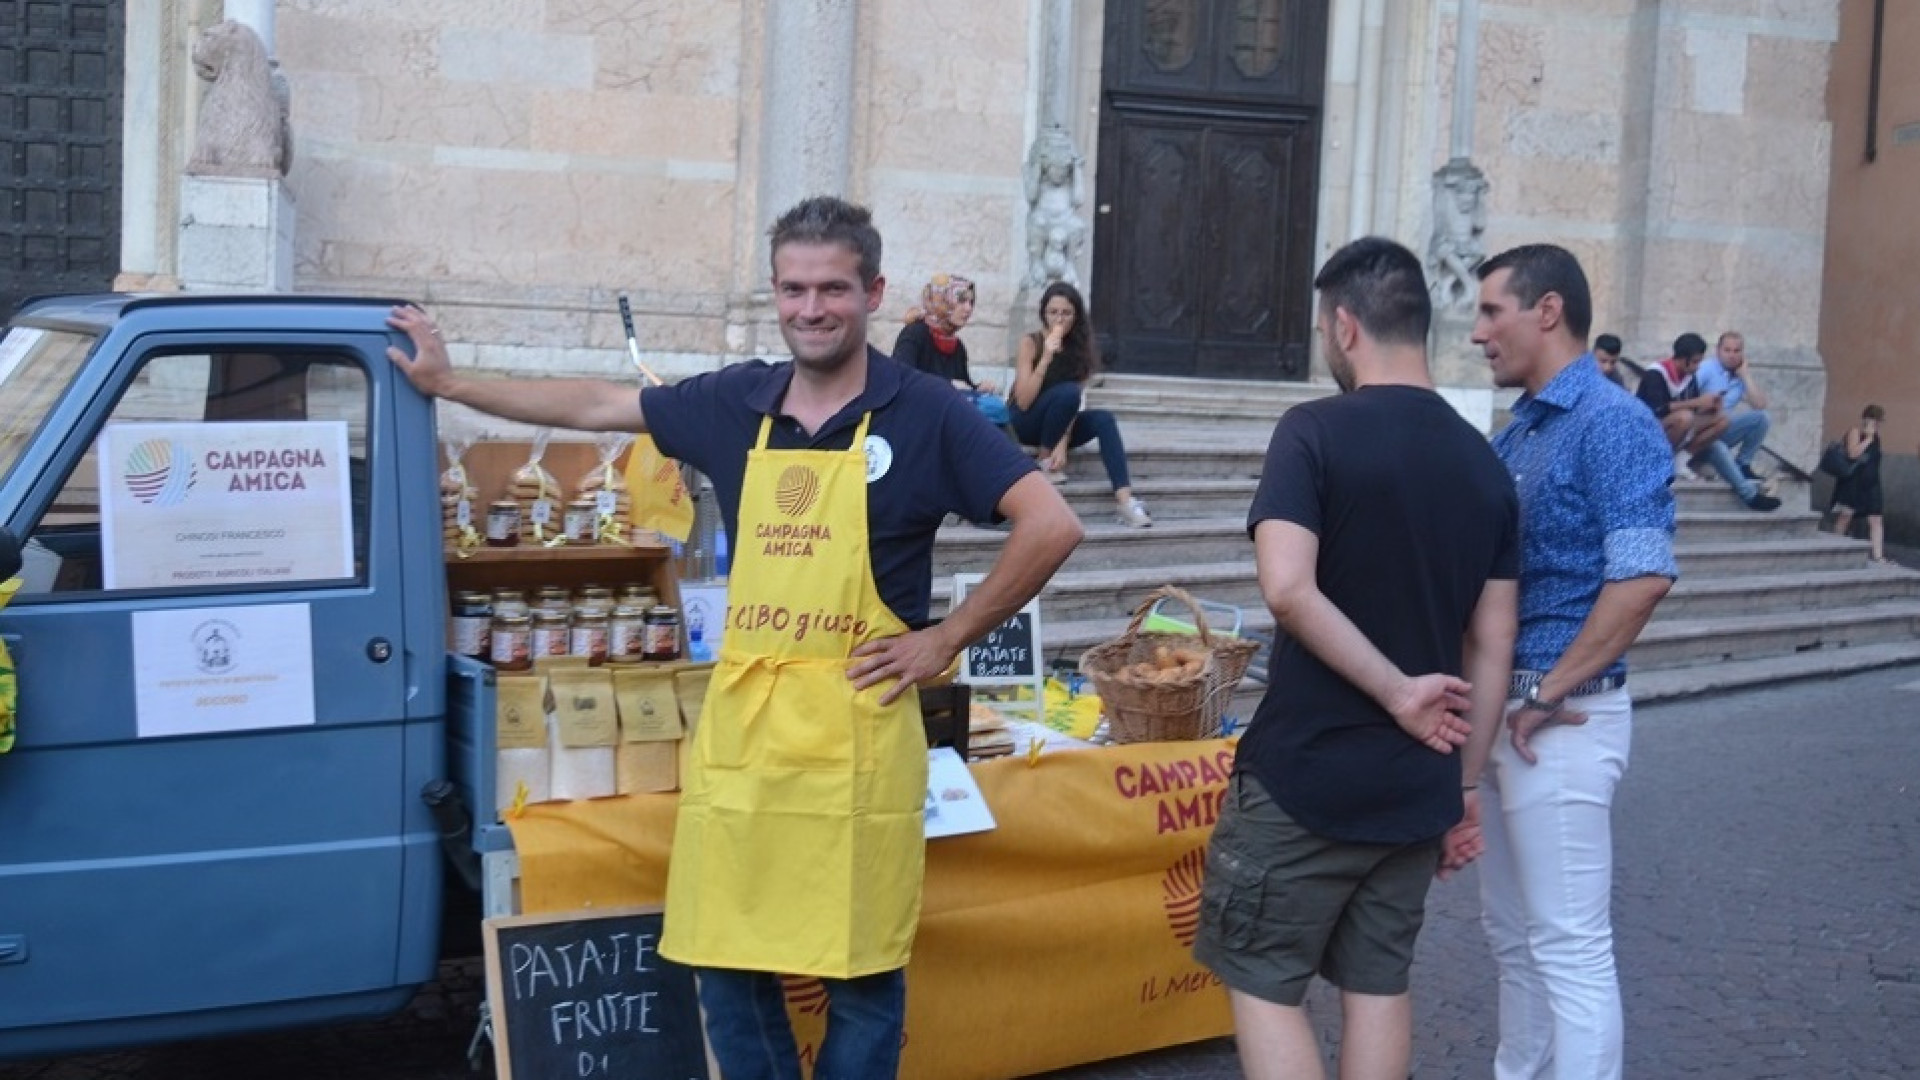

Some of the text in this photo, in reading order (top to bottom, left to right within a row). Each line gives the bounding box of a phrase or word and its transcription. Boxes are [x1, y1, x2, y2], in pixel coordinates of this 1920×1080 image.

[205, 449, 326, 470] CAMPAGNA
[228, 471, 306, 491] AMICA
[755, 523, 832, 541] CAMPAGNA
[763, 541, 814, 557] AMICA
[734, 604, 790, 632] CIBO
[970, 646, 1028, 662] PATATE
[510, 933, 658, 1000] PATATE
[550, 991, 661, 1045] FRITTE
